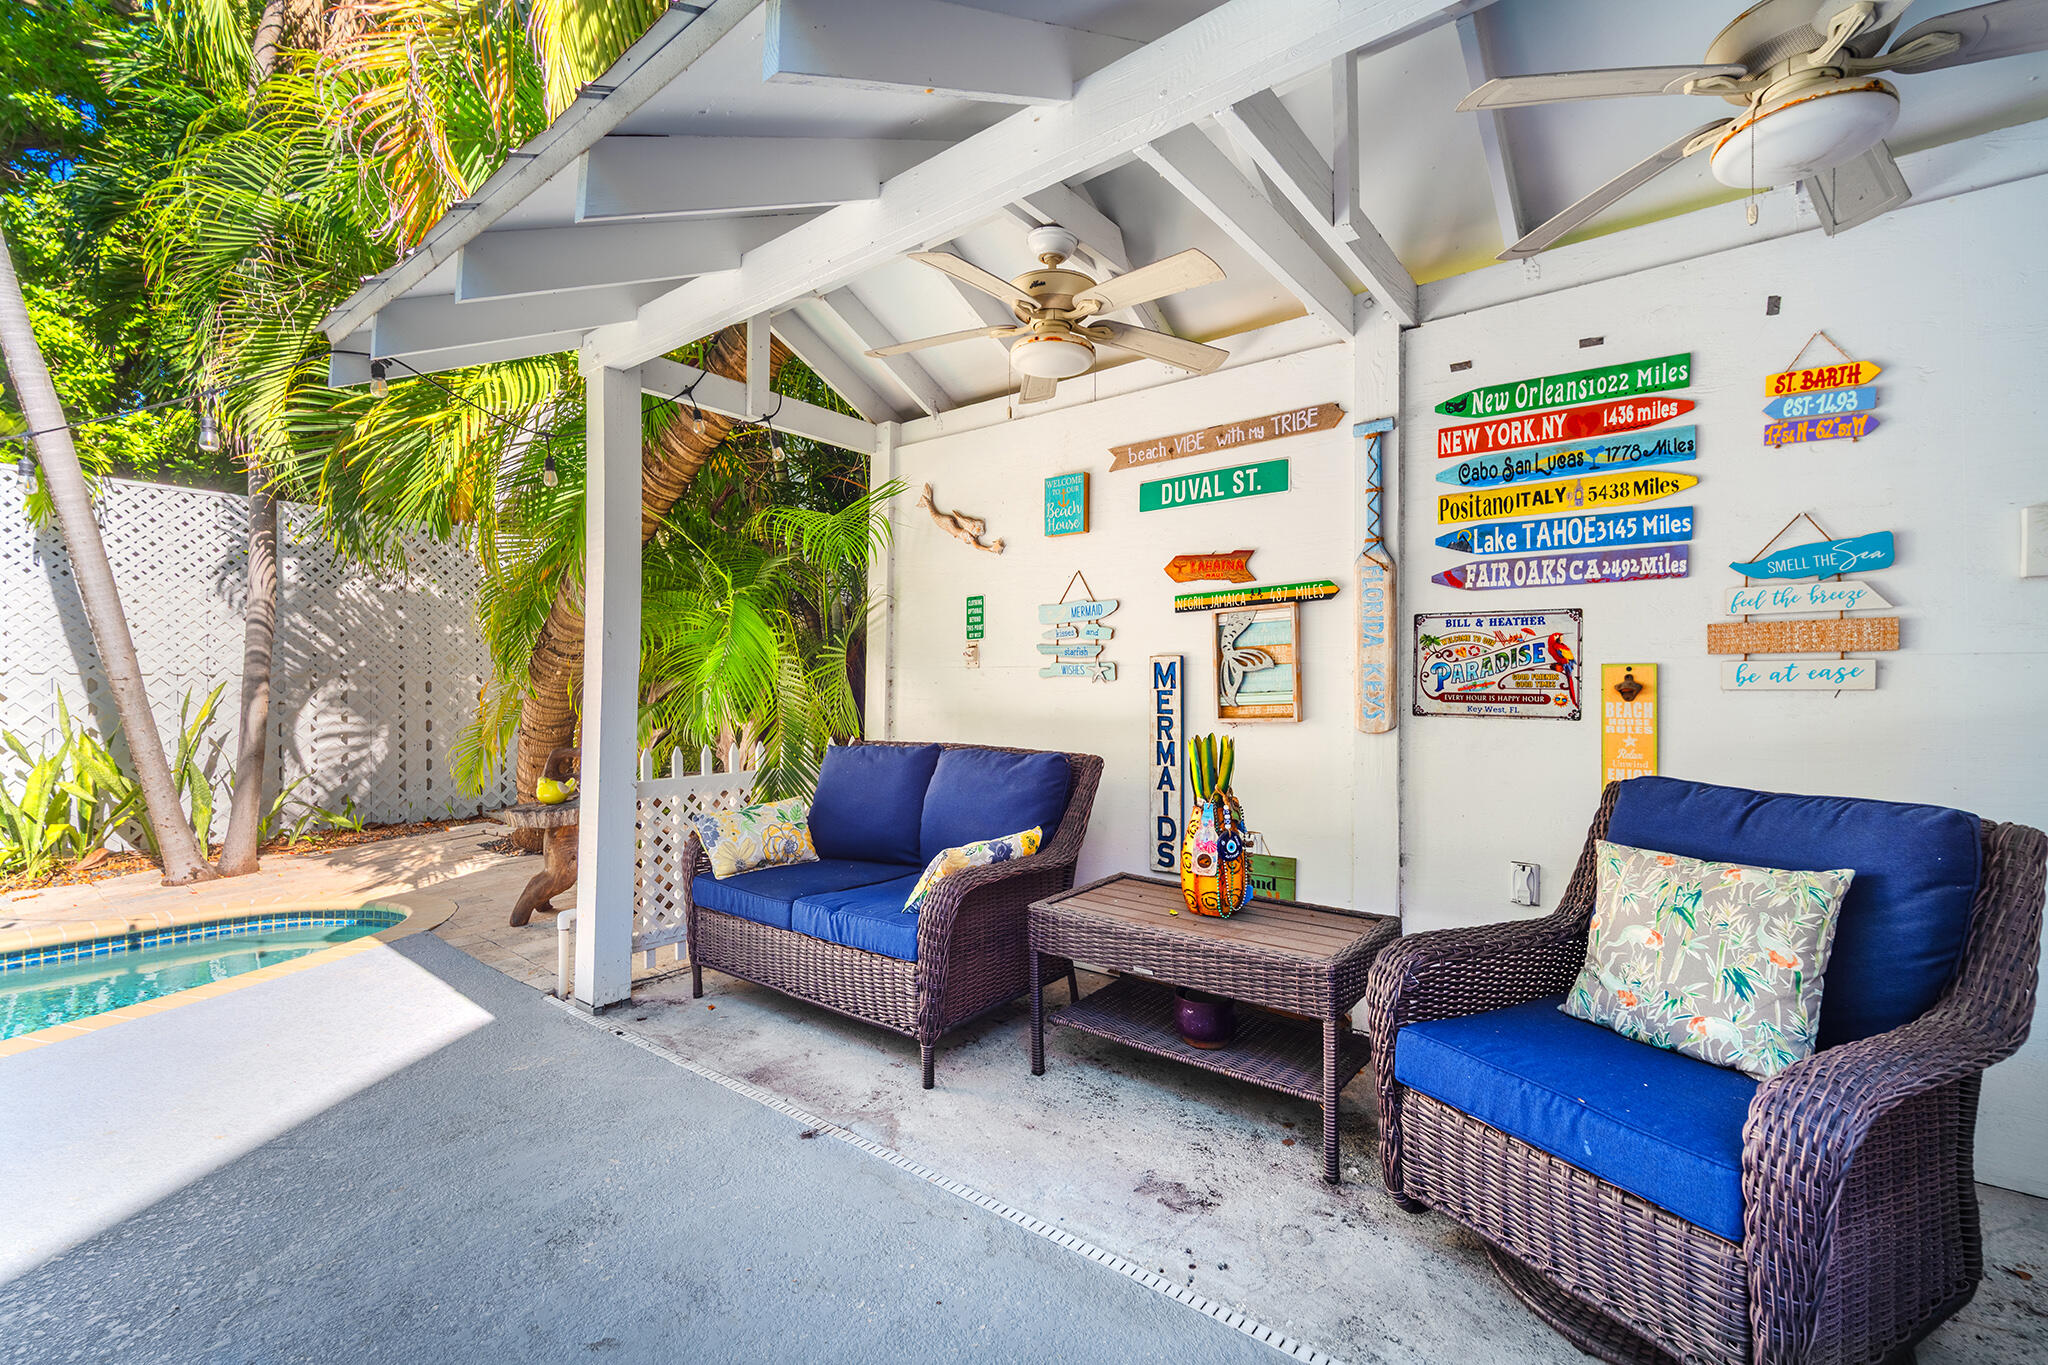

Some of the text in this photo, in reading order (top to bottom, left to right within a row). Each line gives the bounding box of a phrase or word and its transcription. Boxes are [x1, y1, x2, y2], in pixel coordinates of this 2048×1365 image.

[1472, 362, 1688, 415] New Orleans 1022 Miles
[1775, 363, 1861, 393] ST. BARTH
[1128, 442, 1167, 464] beach
[1174, 432, 1205, 454] VIBE
[1216, 427, 1245, 446] with
[1271, 408, 1318, 435] TRIBE
[1440, 428, 1479, 454] NEW
[1603, 405, 1634, 427] 1436
[1637, 400, 1678, 420] miles
[1459, 463, 1498, 484] Cabo
[1502, 457, 1531, 481] San
[1606, 445, 1641, 462] 1778
[1643, 440, 1694, 457] Miles
[1047, 475, 1082, 488] WELCOME
[1161, 469, 1261, 505] DUVAL ST.
[1047, 501, 1082, 518] Beach
[1440, 477, 1679, 521] Positano ITALY 5438 Miles
[1048, 518, 1080, 532] House
[1473, 514, 1691, 553] Lake TAHOE 3145 Miles
[1191, 559, 1244, 574] LAHAINA
[1768, 541, 1885, 574] SMELL THE Sea
[1465, 553, 1687, 588] FAIR OAKS CA 2492 Miles
[1209, 592, 1246, 608] JAMAICA
[1270, 587, 1288, 602] 487
[1296, 584, 1324, 600] MILES
[1731, 584, 1867, 613] feel the breeze
[1071, 604, 1102, 618] MERMAID
[1445, 616, 1546, 628] BILL & HEATHER
[1064, 647, 1088, 656] starfish
[1362, 565, 1385, 722] FLORIDA KEYS
[1440, 635, 1471, 645] WELCOME
[1482, 637, 1496, 647] OUR
[1061, 665, 1085, 675] WISHES
[1430, 642, 1546, 692] PARADISE
[1531, 673, 1559, 681] FRIENDS
[1736, 663, 1864, 686] be at ease
[1606, 702, 1653, 718] BEACH
[1606, 726, 1653, 734] RULES
[1154, 662, 1176, 868] MERMAIDS
[1612, 760, 1648, 768] Unwind
